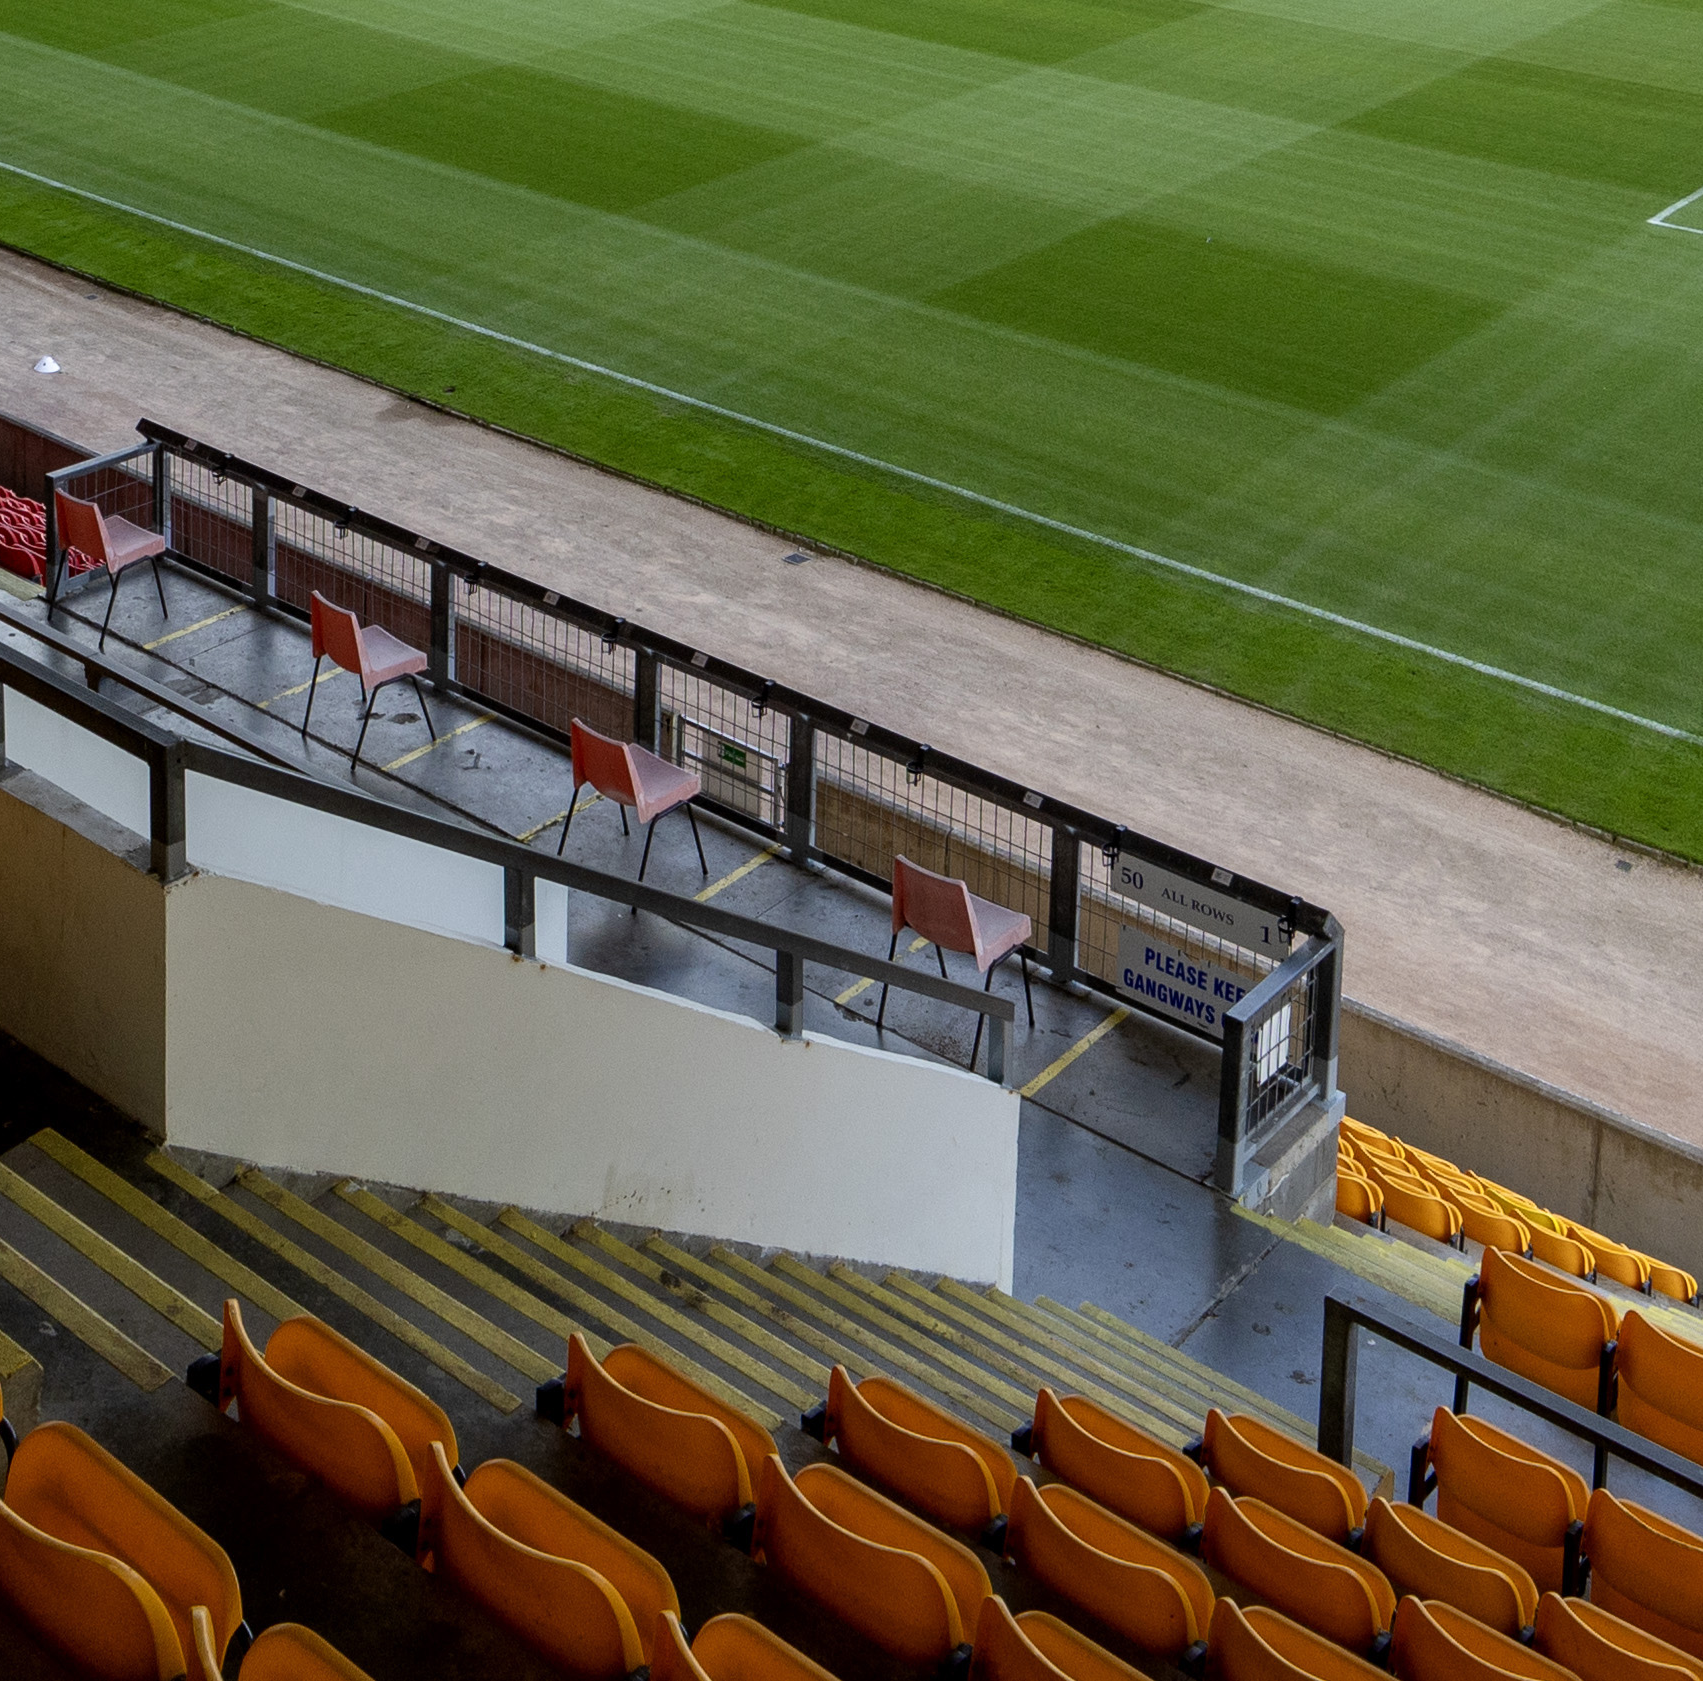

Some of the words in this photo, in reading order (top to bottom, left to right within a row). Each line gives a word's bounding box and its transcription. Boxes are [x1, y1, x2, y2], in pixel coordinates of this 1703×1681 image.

[1120, 867, 1144, 890] 50
[1161, 886, 1188, 908] ALL
[1191, 898, 1235, 926] ROWS
[1123, 968, 1216, 1026] GANGWAYS
[1144, 946, 1207, 990] PLEASE
[1213, 970, 1246, 1005] KEE
